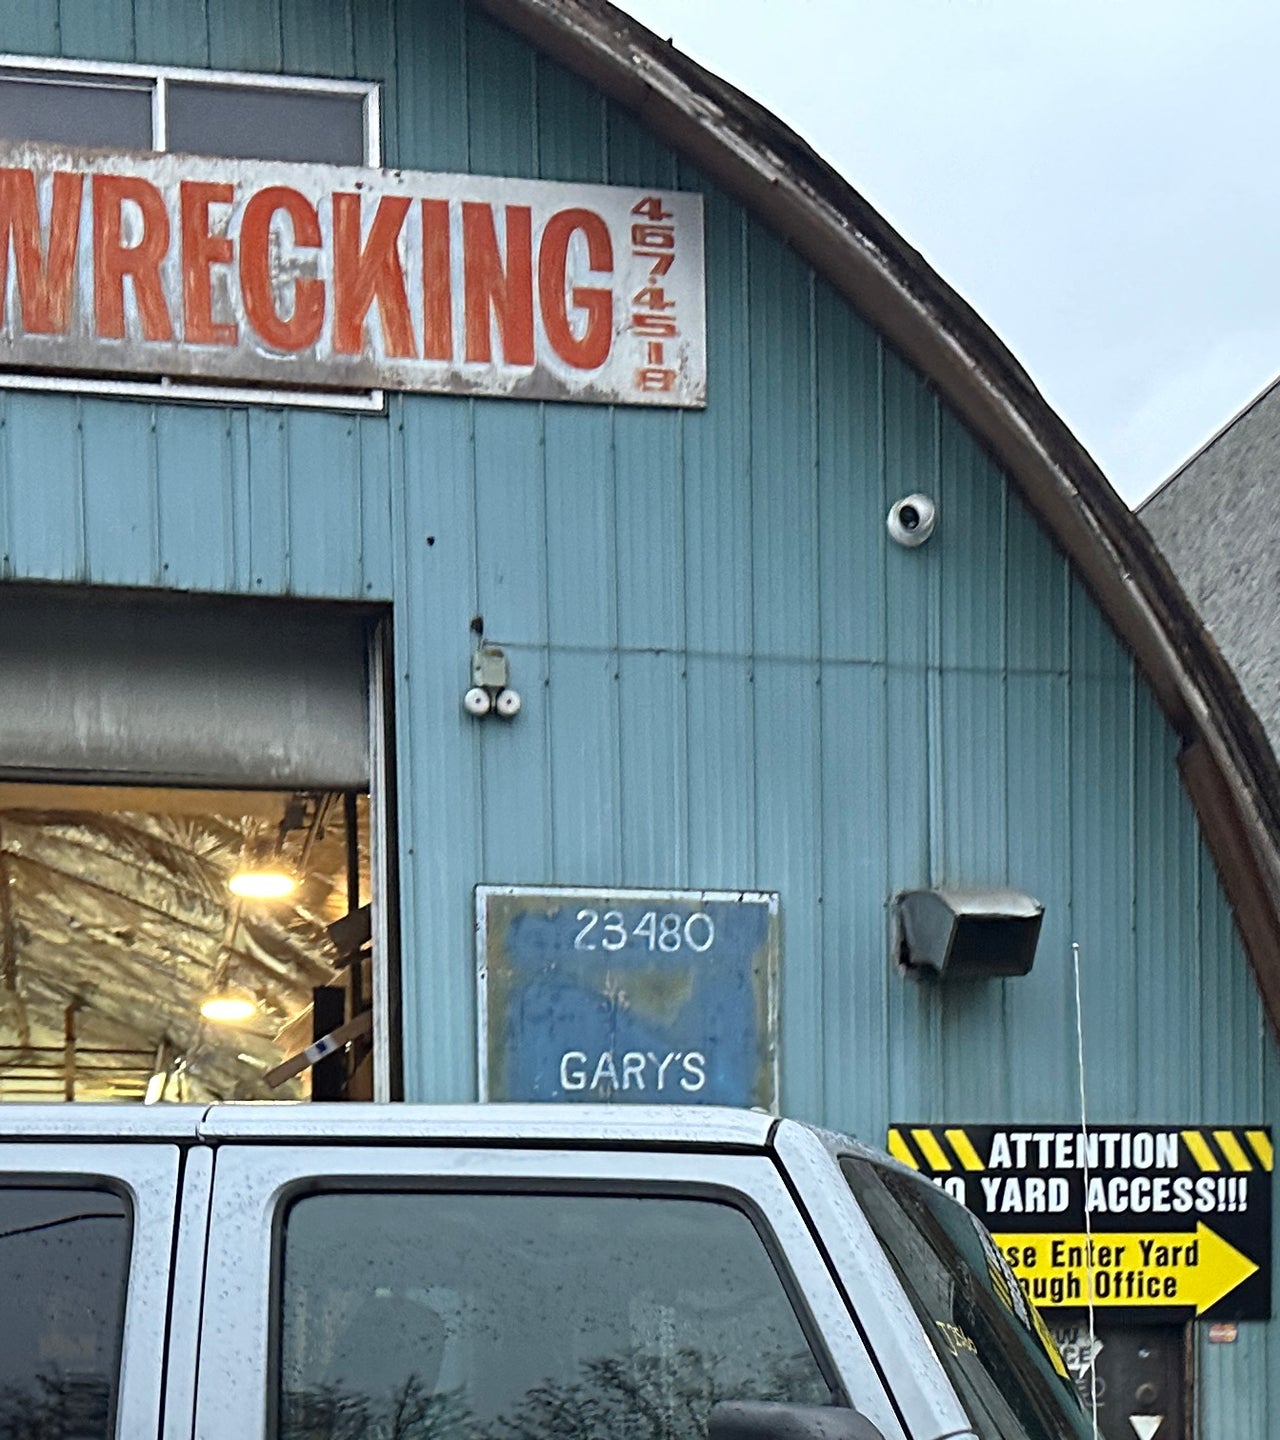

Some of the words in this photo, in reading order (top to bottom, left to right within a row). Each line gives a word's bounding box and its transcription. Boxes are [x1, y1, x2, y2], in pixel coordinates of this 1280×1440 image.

[573, 908, 716, 952] 23480
[559, 1051, 706, 1091] GARY'S
[988, 1132, 1179, 1169] ATTENTION
[933, 1177, 965, 1205] O
[980, 1177, 1070, 1213] YARD
[1087, 1176, 1248, 1213] ACCESS!!!
[1051, 1240, 1125, 1268] Enter
[1139, 1239, 1199, 1267] Yard
[1018, 1271, 1081, 1303] ough
[1095, 1271, 1177, 1298] Office
